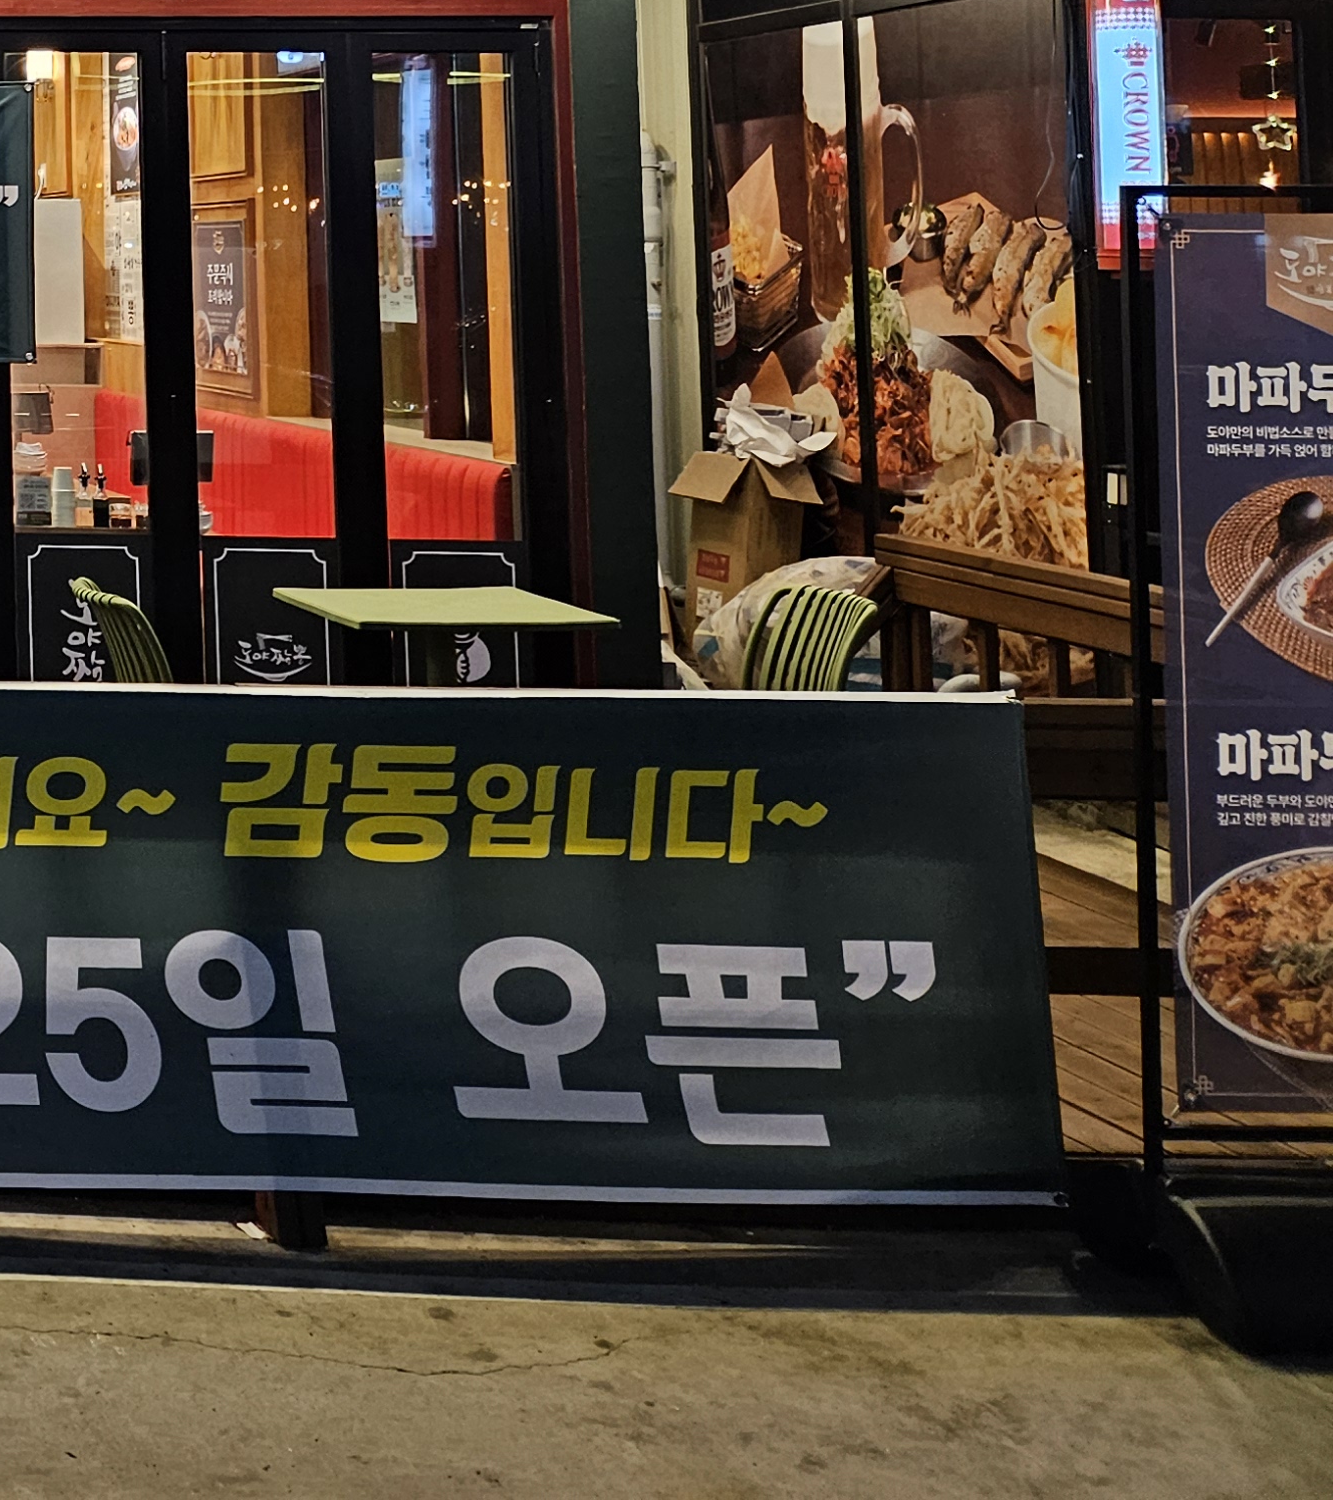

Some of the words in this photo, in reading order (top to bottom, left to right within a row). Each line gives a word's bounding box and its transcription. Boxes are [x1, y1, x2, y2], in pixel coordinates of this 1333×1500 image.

[1121, 70, 1155, 174] CROWN
[1206, 425, 1254, 440] 도야만의
[1256, 425, 1314, 440] 비법소스로
[1206, 443, 1266, 458] 마파두부를
[1268, 443, 1292, 458] 가득
[1320, 443, 1333, 458] 함
[218, 742, 829, 865] 감동입니다~
[1216, 793, 1264, 809] 부드러운
[1266, 793, 1302, 809] 두부와
[1217, 811, 1241, 827] 깊고
[1243, 811, 1267, 827] 진한
[1270, 811, 1306, 827] 풍미로
[453, 934, 938, 1149] 오픈”
